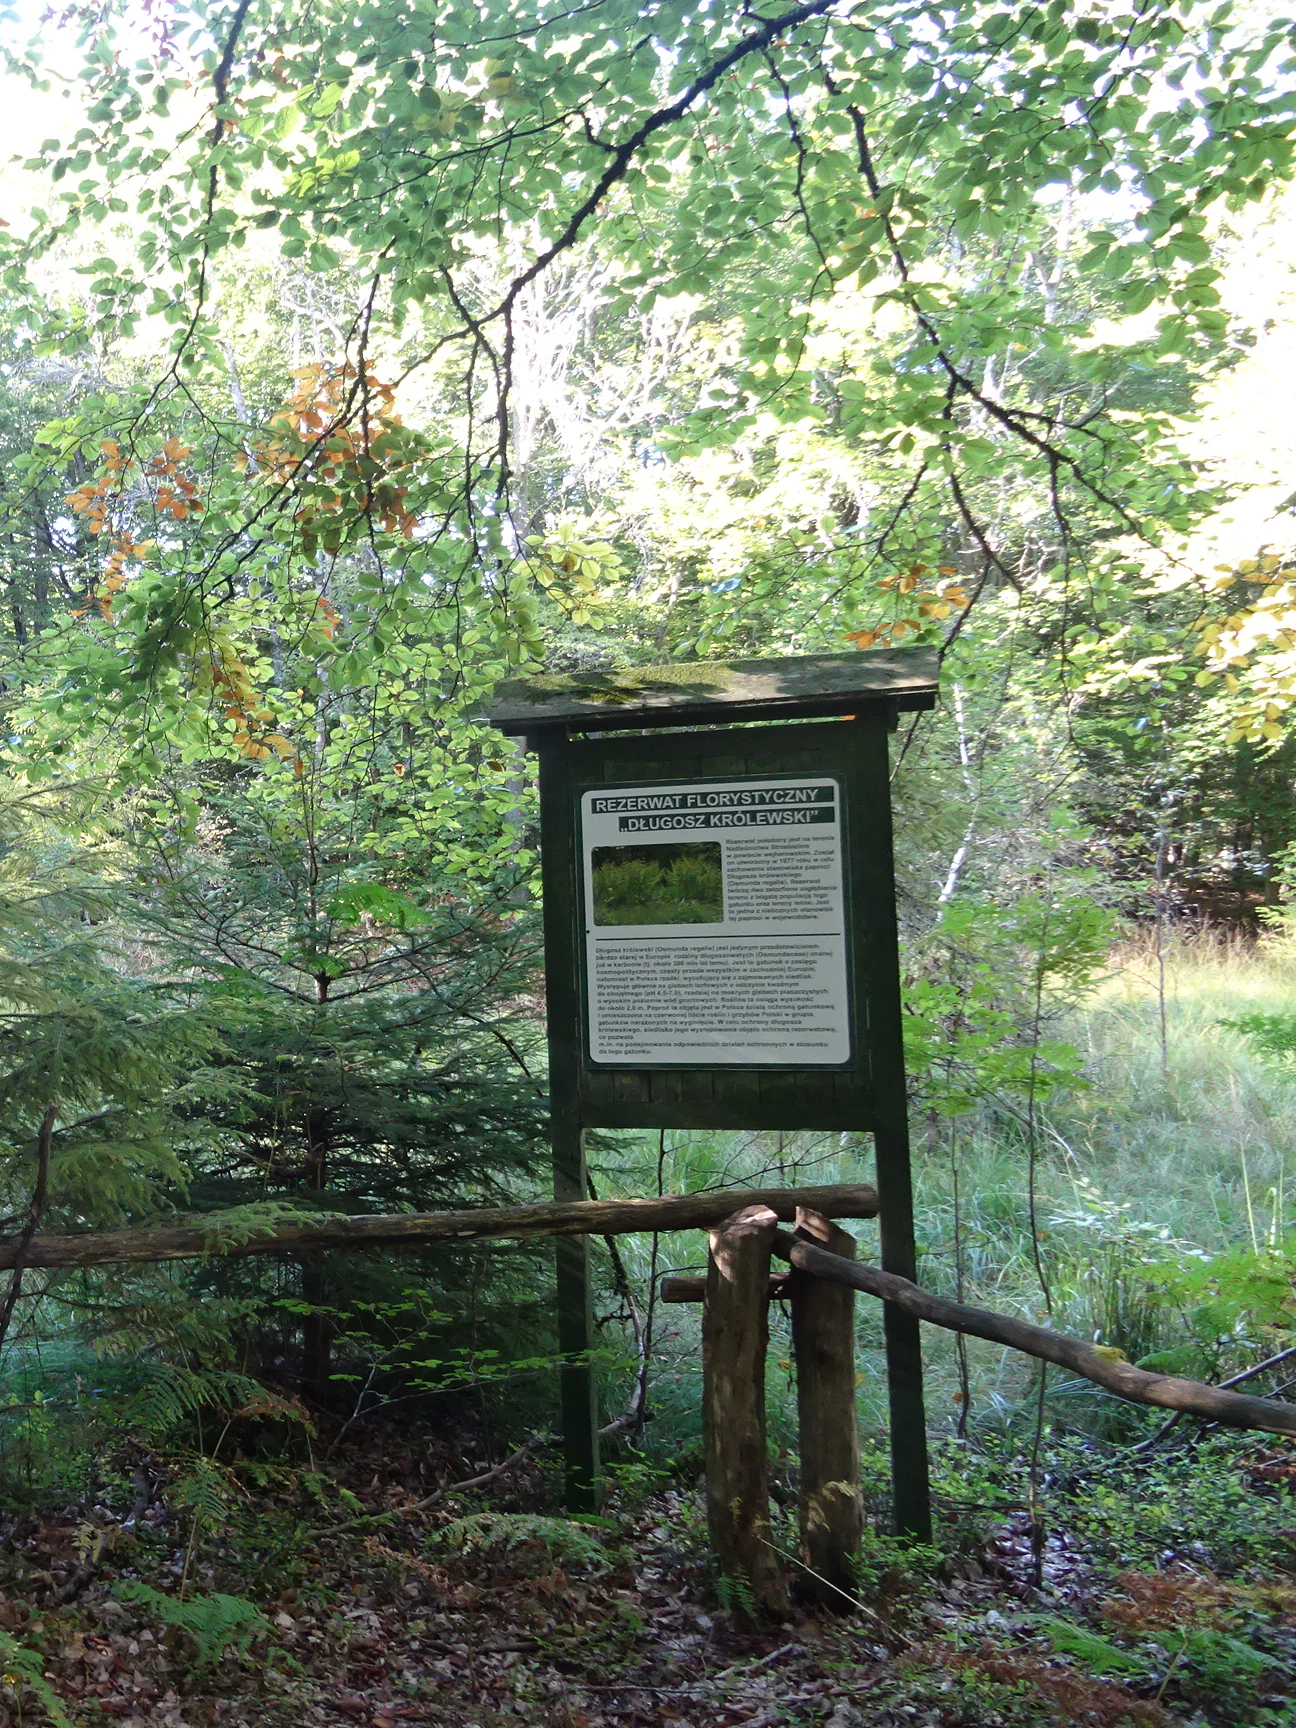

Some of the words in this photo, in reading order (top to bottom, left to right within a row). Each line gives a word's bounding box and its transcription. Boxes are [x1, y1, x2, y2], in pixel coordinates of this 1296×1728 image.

[596, 796, 682, 811] REZERWAT
[688, 789, 819, 807] FLORYSTYCZNY
[621, 816, 706, 832] „DŁUGOSZ
[711, 810, 818, 827] KRÓLEWSKI”
